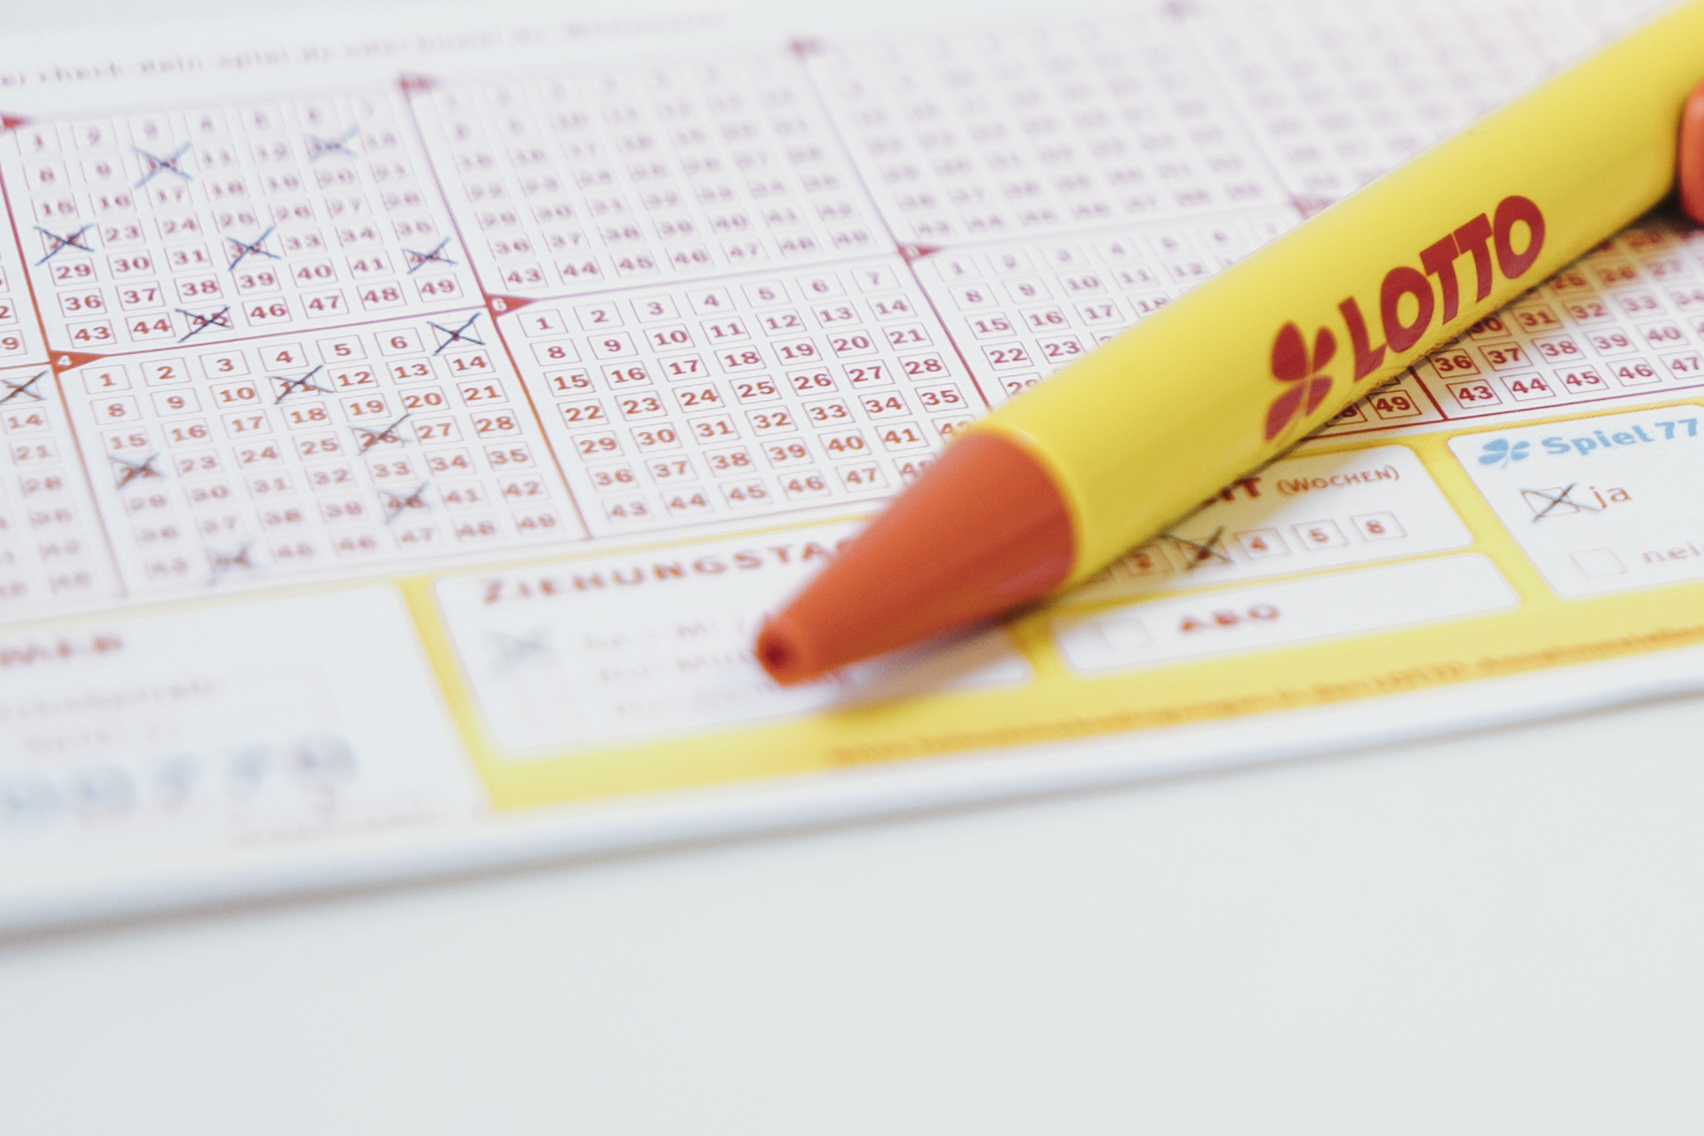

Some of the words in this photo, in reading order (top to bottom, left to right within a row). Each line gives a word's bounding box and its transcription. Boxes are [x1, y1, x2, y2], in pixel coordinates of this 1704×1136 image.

[57, 264, 91, 279] 29
[121, 257, 150, 271] 30
[66, 295, 102, 310] 36
[124, 288, 156, 303] 37
[184, 281, 219, 296] 38
[242, 273, 274, 288] 39
[298, 266, 332, 279] 40
[1338, 195, 1545, 382] LOTTO
[75, 327, 110, 341] 43
[133, 319, 172, 334] 44
[251, 304, 287, 318] 46
[309, 296, 338, 310] 47
[362, 288, 399, 303] 48
[421, 280, 454, 294] 49
[537, 318, 551, 330] 1
[591, 310, 608, 323] 2
[648, 302, 664, 315] 3
[704, 295, 719, 307] 4
[548, 347, 566, 358] 8
[604, 340, 621, 352] 9
[655, 331, 688, 345] 10
[711, 323, 742, 337] 11
[766, 315, 800, 329] 12
[821, 308, 852, 322] 13
[876, 300, 907, 314] 14
[976, 319, 1009, 333] 15
[1031, 312, 1063, 326] 16
[1086, 305, 1111, 319] 17
[1520, 311, 1555, 326] 31
[1570, 301, 1606, 319] 32
[100, 373, 115, 387] 1
[157, 366, 175, 379] 2
[217, 358, 234, 372] 3
[276, 351, 292, 363] 4
[334, 343, 351, 356] 5
[391, 336, 407, 349] 6
[555, 375, 590, 390] 15
[612, 368, 646, 383] 16
[670, 360, 697, 375] 17
[725, 352, 760, 367] 18
[781, 344, 814, 359] 19
[833, 337, 869, 354] 20
[890, 329, 924, 344] 21
[990, 348, 1027, 364] 22
[1045, 341, 1080, 357] 23
[1434, 353, 1473, 372] 36
[1487, 346, 1521, 365] 37
[1541, 339, 1578, 356] 38
[1594, 335, 1629, 349] 39
[1647, 328, 1682, 341] 40
[108, 404, 125, 417] 8
[167, 396, 184, 409] 9
[221, 387, 256, 402] 10
[338, 372, 372, 387] 12
[395, 364, 428, 378] 13
[454, 356, 486, 371] 14
[565, 406, 603, 422] 22
[623, 398, 660, 414] 23
[681, 389, 719, 406] 24
[738, 381, 775, 398] 25
[794, 374, 832, 390] 26
[849, 366, 880, 382] 27
[905, 359, 942, 375] 28
[1459, 386, 1493, 401] 43
[1512, 378, 1547, 393] 44
[1566, 372, 1600, 386] 45
[1619, 365, 1654, 379] 46
[1672, 357, 1699, 372] 47
[111, 434, 147, 449] 15
[172, 425, 207, 441] 16
[232, 416, 263, 432] 17
[291, 408, 327, 423] 18
[350, 400, 384, 415] 19
[403, 393, 442, 413] 20
[464, 386, 499, 402] 21
[580, 438, 617, 454] 29
[638, 429, 676, 445] 30
[697, 421, 733, 437] 31
[754, 413, 791, 428] 32
[811, 405, 847, 420] 33
[866, 397, 902, 413] 34
[922, 390, 959, 406] 35
[1376, 396, 1410, 412] 49
[181, 456, 217, 473] 23
[242, 447, 278, 463] 24
[301, 439, 339, 455] 25
[417, 423, 450, 441] 27
[474, 417, 514, 434] 28
[596, 469, 634, 486] 36
[654, 461, 687, 478] 37
[713, 453, 750, 469] 38
[770, 445, 806, 461] 39
[828, 436, 864, 451] 40
[883, 429, 918, 443] 41
[1541, 424, 1655, 456] Spiel
[1655, 417, 1698, 441] 77
[431, 455, 468, 473] 34
[489, 449, 528, 467] 35
[1277, 465, 1400, 496] (WOCHEN)
[611, 502, 647, 517] 43
[670, 494, 706, 509] 44
[729, 485, 766, 500] 45
[788, 477, 825, 492] 46
[846, 468, 876, 484] 47
[1588, 486, 1632, 510] ja
[481, 540, 838, 603] ZIEHUNGSTA
